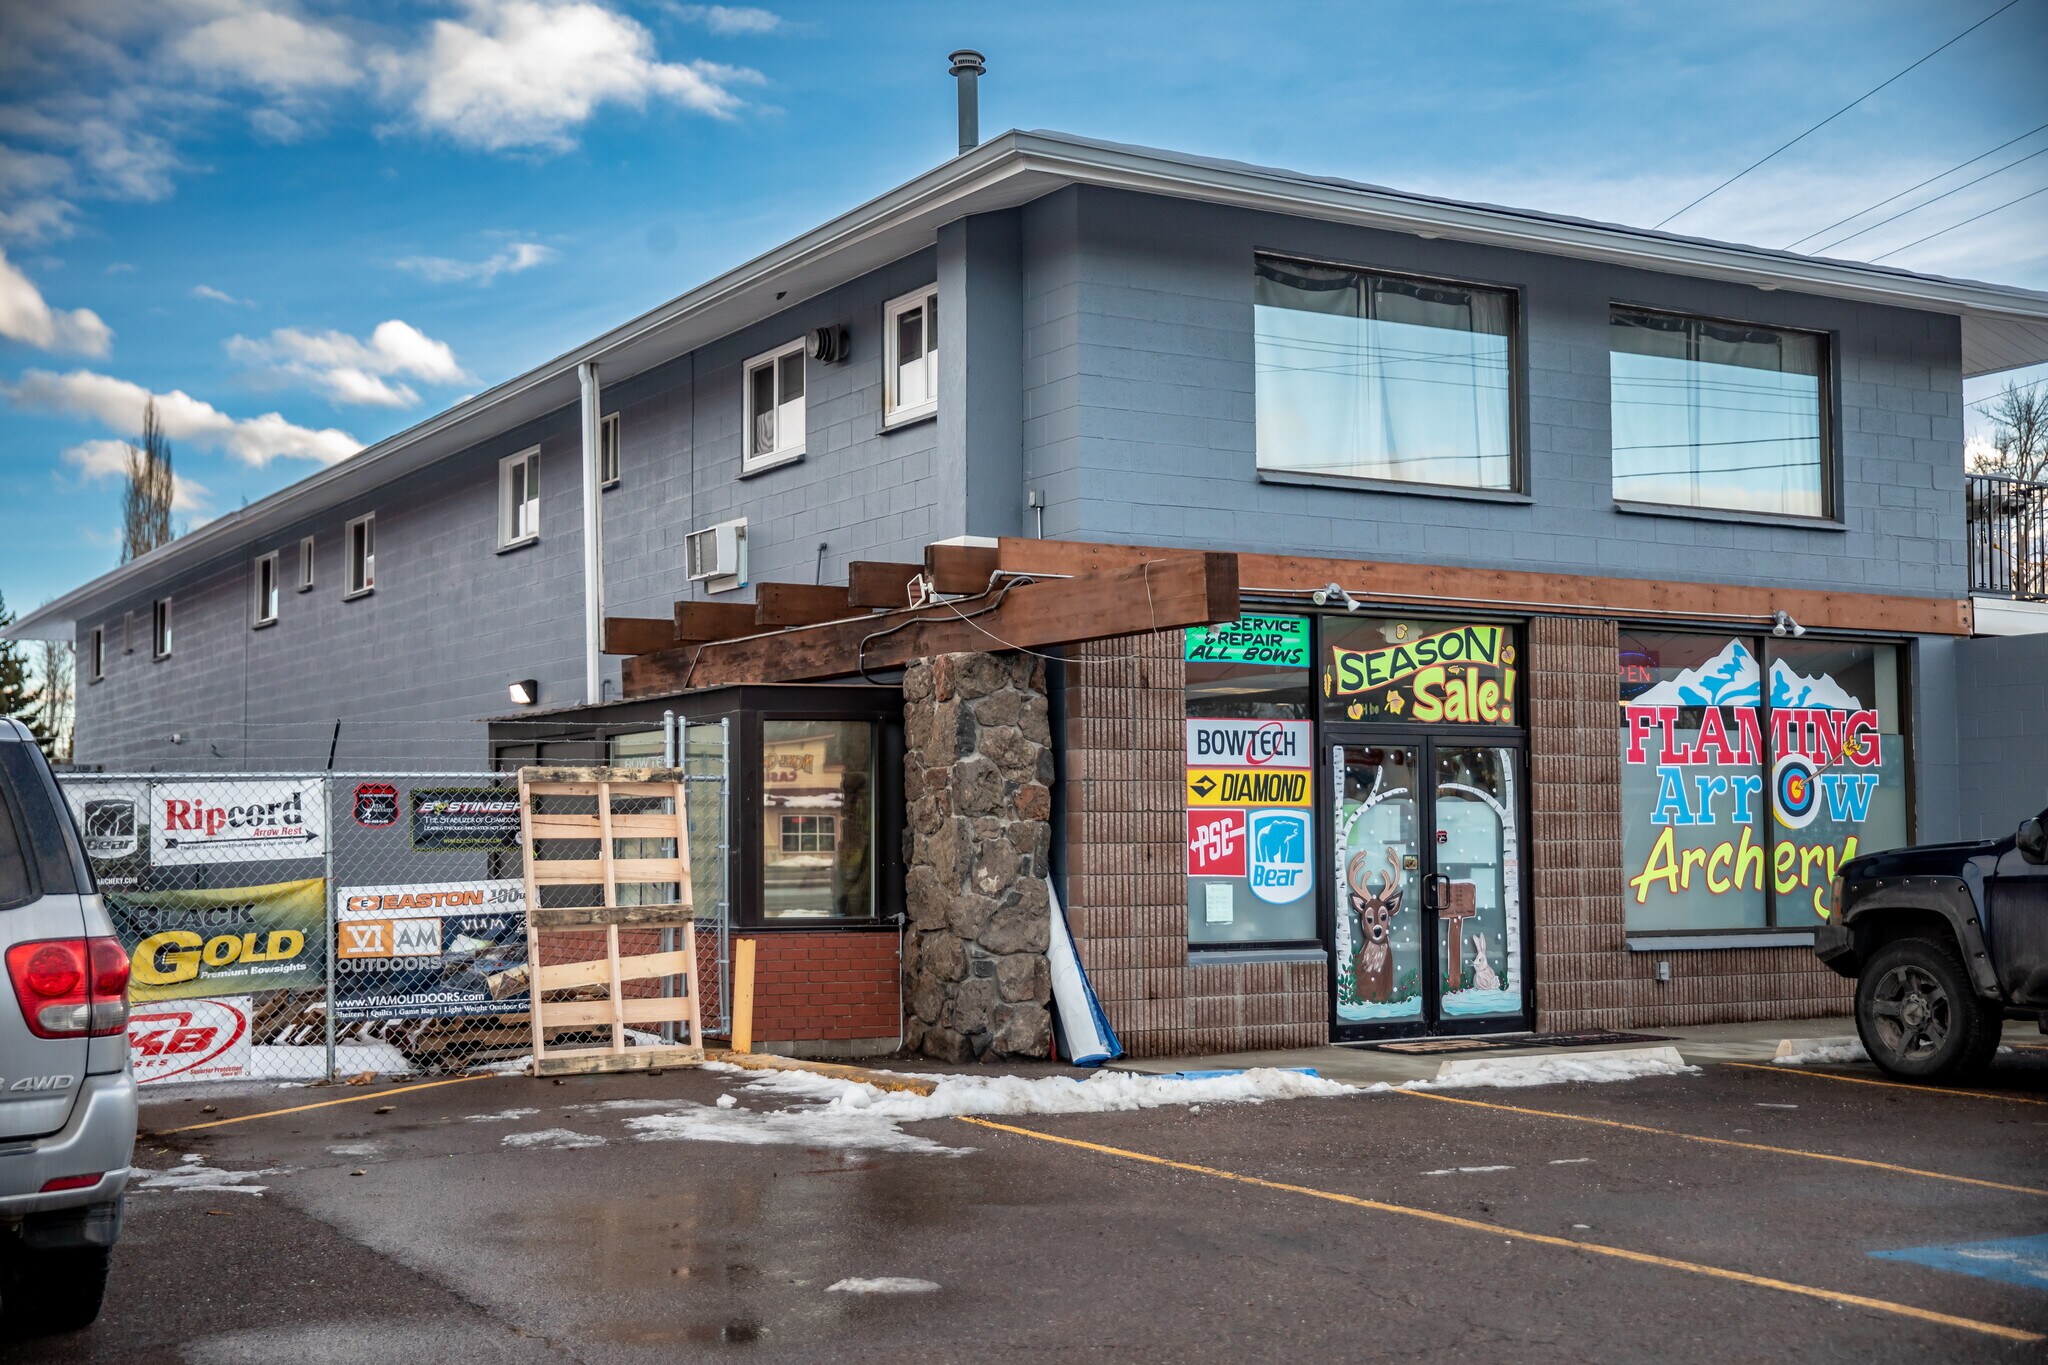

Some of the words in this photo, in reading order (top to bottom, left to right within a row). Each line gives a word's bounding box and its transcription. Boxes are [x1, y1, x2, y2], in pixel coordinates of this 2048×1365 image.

[1230, 617, 1301, 633] SERVICE
[1217, 632, 1284, 647] REPAIR
[1188, 645, 1232, 661] ALL
[1242, 647, 1304, 665] BOWS
[1340, 627, 1497, 691] SEASON
[1618, 664, 1651, 683] PEN
[1412, 665, 1517, 723] Sale!
[1197, 729, 1296, 757] BOWTECH
[1625, 705, 1882, 767] FLAMING
[1220, 773, 1306, 802] DIAMOND
[164, 792, 304, 836] Ripcord
[253, 828, 280, 837] Arrow
[281, 826, 303, 836] Rest
[1195, 817, 1234, 867] PSE
[86, 839, 134, 851] Bear
[1252, 865, 1303, 887] Bear
[1629, 825, 1858, 920] Archery
[383, 890, 484, 911] EASTON
[128, 904, 257, 932] BLACK
[131, 930, 305, 985] GOLD
[338, 957, 442, 973] OUTDOORS
[200, 968, 249, 980] Premium
[250, 963, 307, 975] Bowsights
[335, 992, 485, 1008] www.VIAMOUTDOORS.com
[444, 1005, 463, 1014] Light
[518, 1002, 531, 1010] Gea
[128, 1026, 218, 1056] KB
[133, 1059, 169, 1068] SES
[10, 1074, 74, 1092] 4WD
